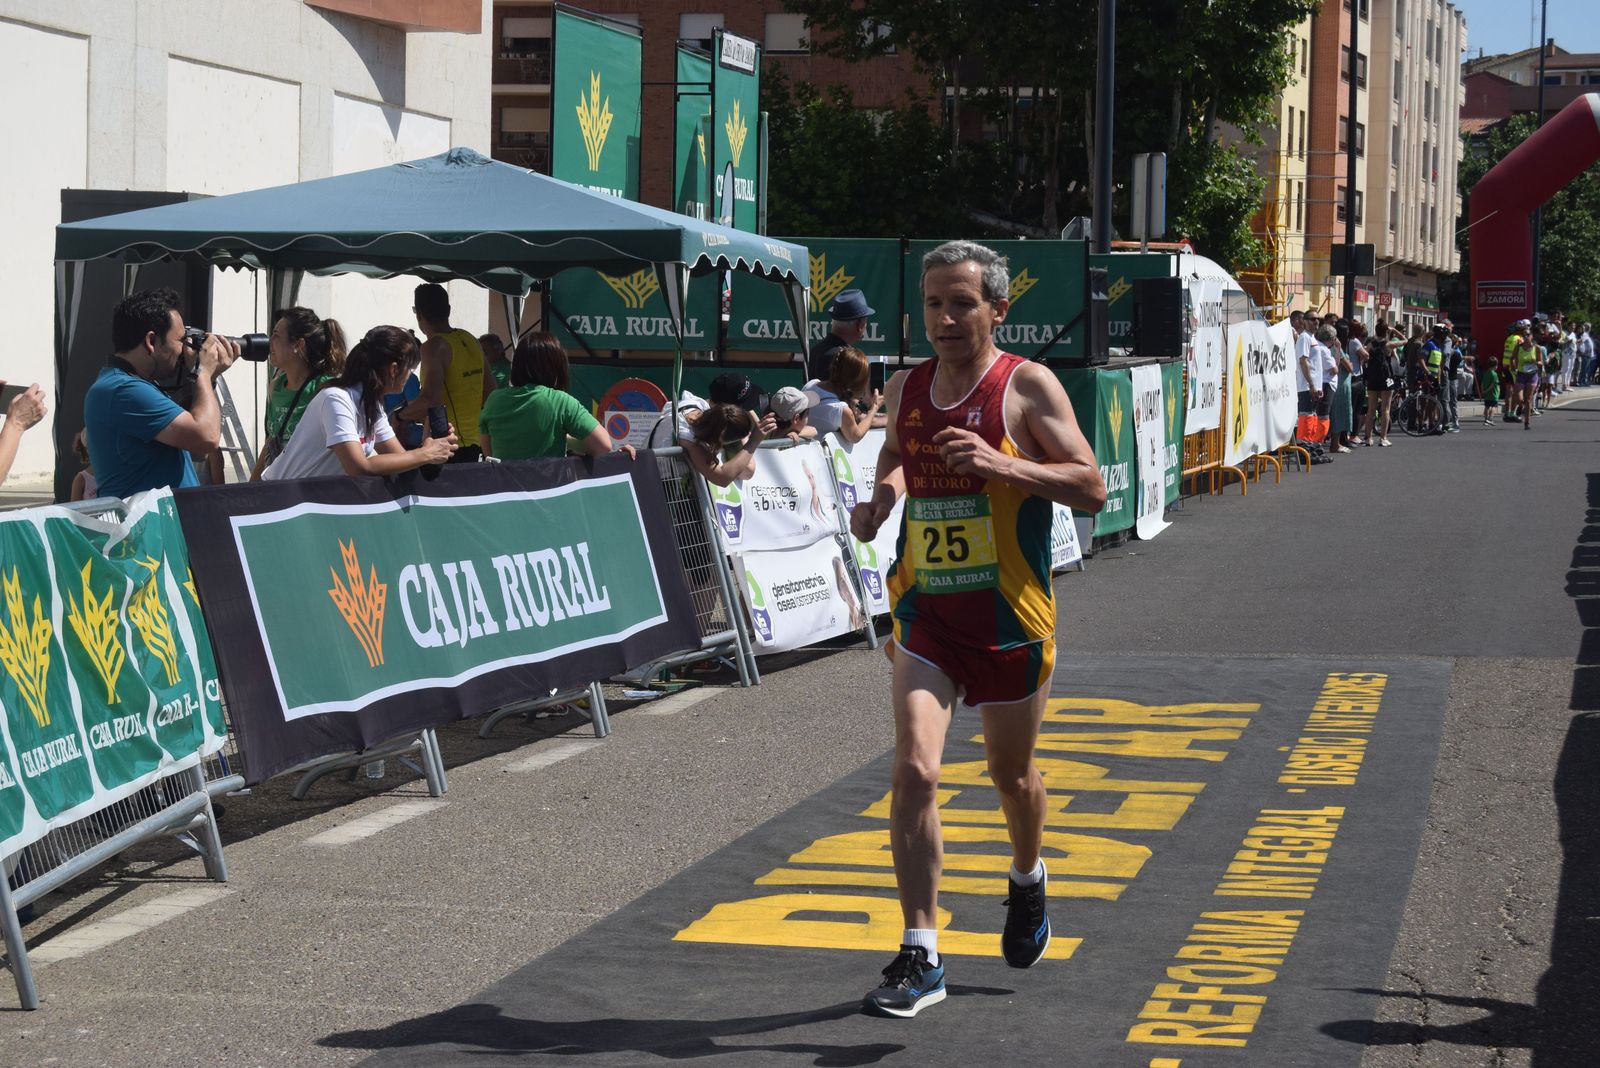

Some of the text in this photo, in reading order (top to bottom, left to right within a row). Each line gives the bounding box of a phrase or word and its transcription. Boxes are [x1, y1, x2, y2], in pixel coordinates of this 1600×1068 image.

[1487, 296, 1525, 304] ZAMORA
[565, 315, 618, 337] CAJA
[742, 319, 885, 342] CAJA RUAL
[992, 324, 1072, 344] RURAL
[912, 477, 971, 489] DE TORO
[923, 508, 977, 520] CAJA RURAL
[923, 525, 970, 564] 25
[929, 571, 994, 586] CAJA RURAL
[399, 541, 612, 649] CAJA RURAL
[21, 744, 50, 778] CAJA
[45, 733, 82, 769] RURAL
[1125, 672, 1389, 1047] REFORMA INTEGRAL DISEÑO INTERIORES
